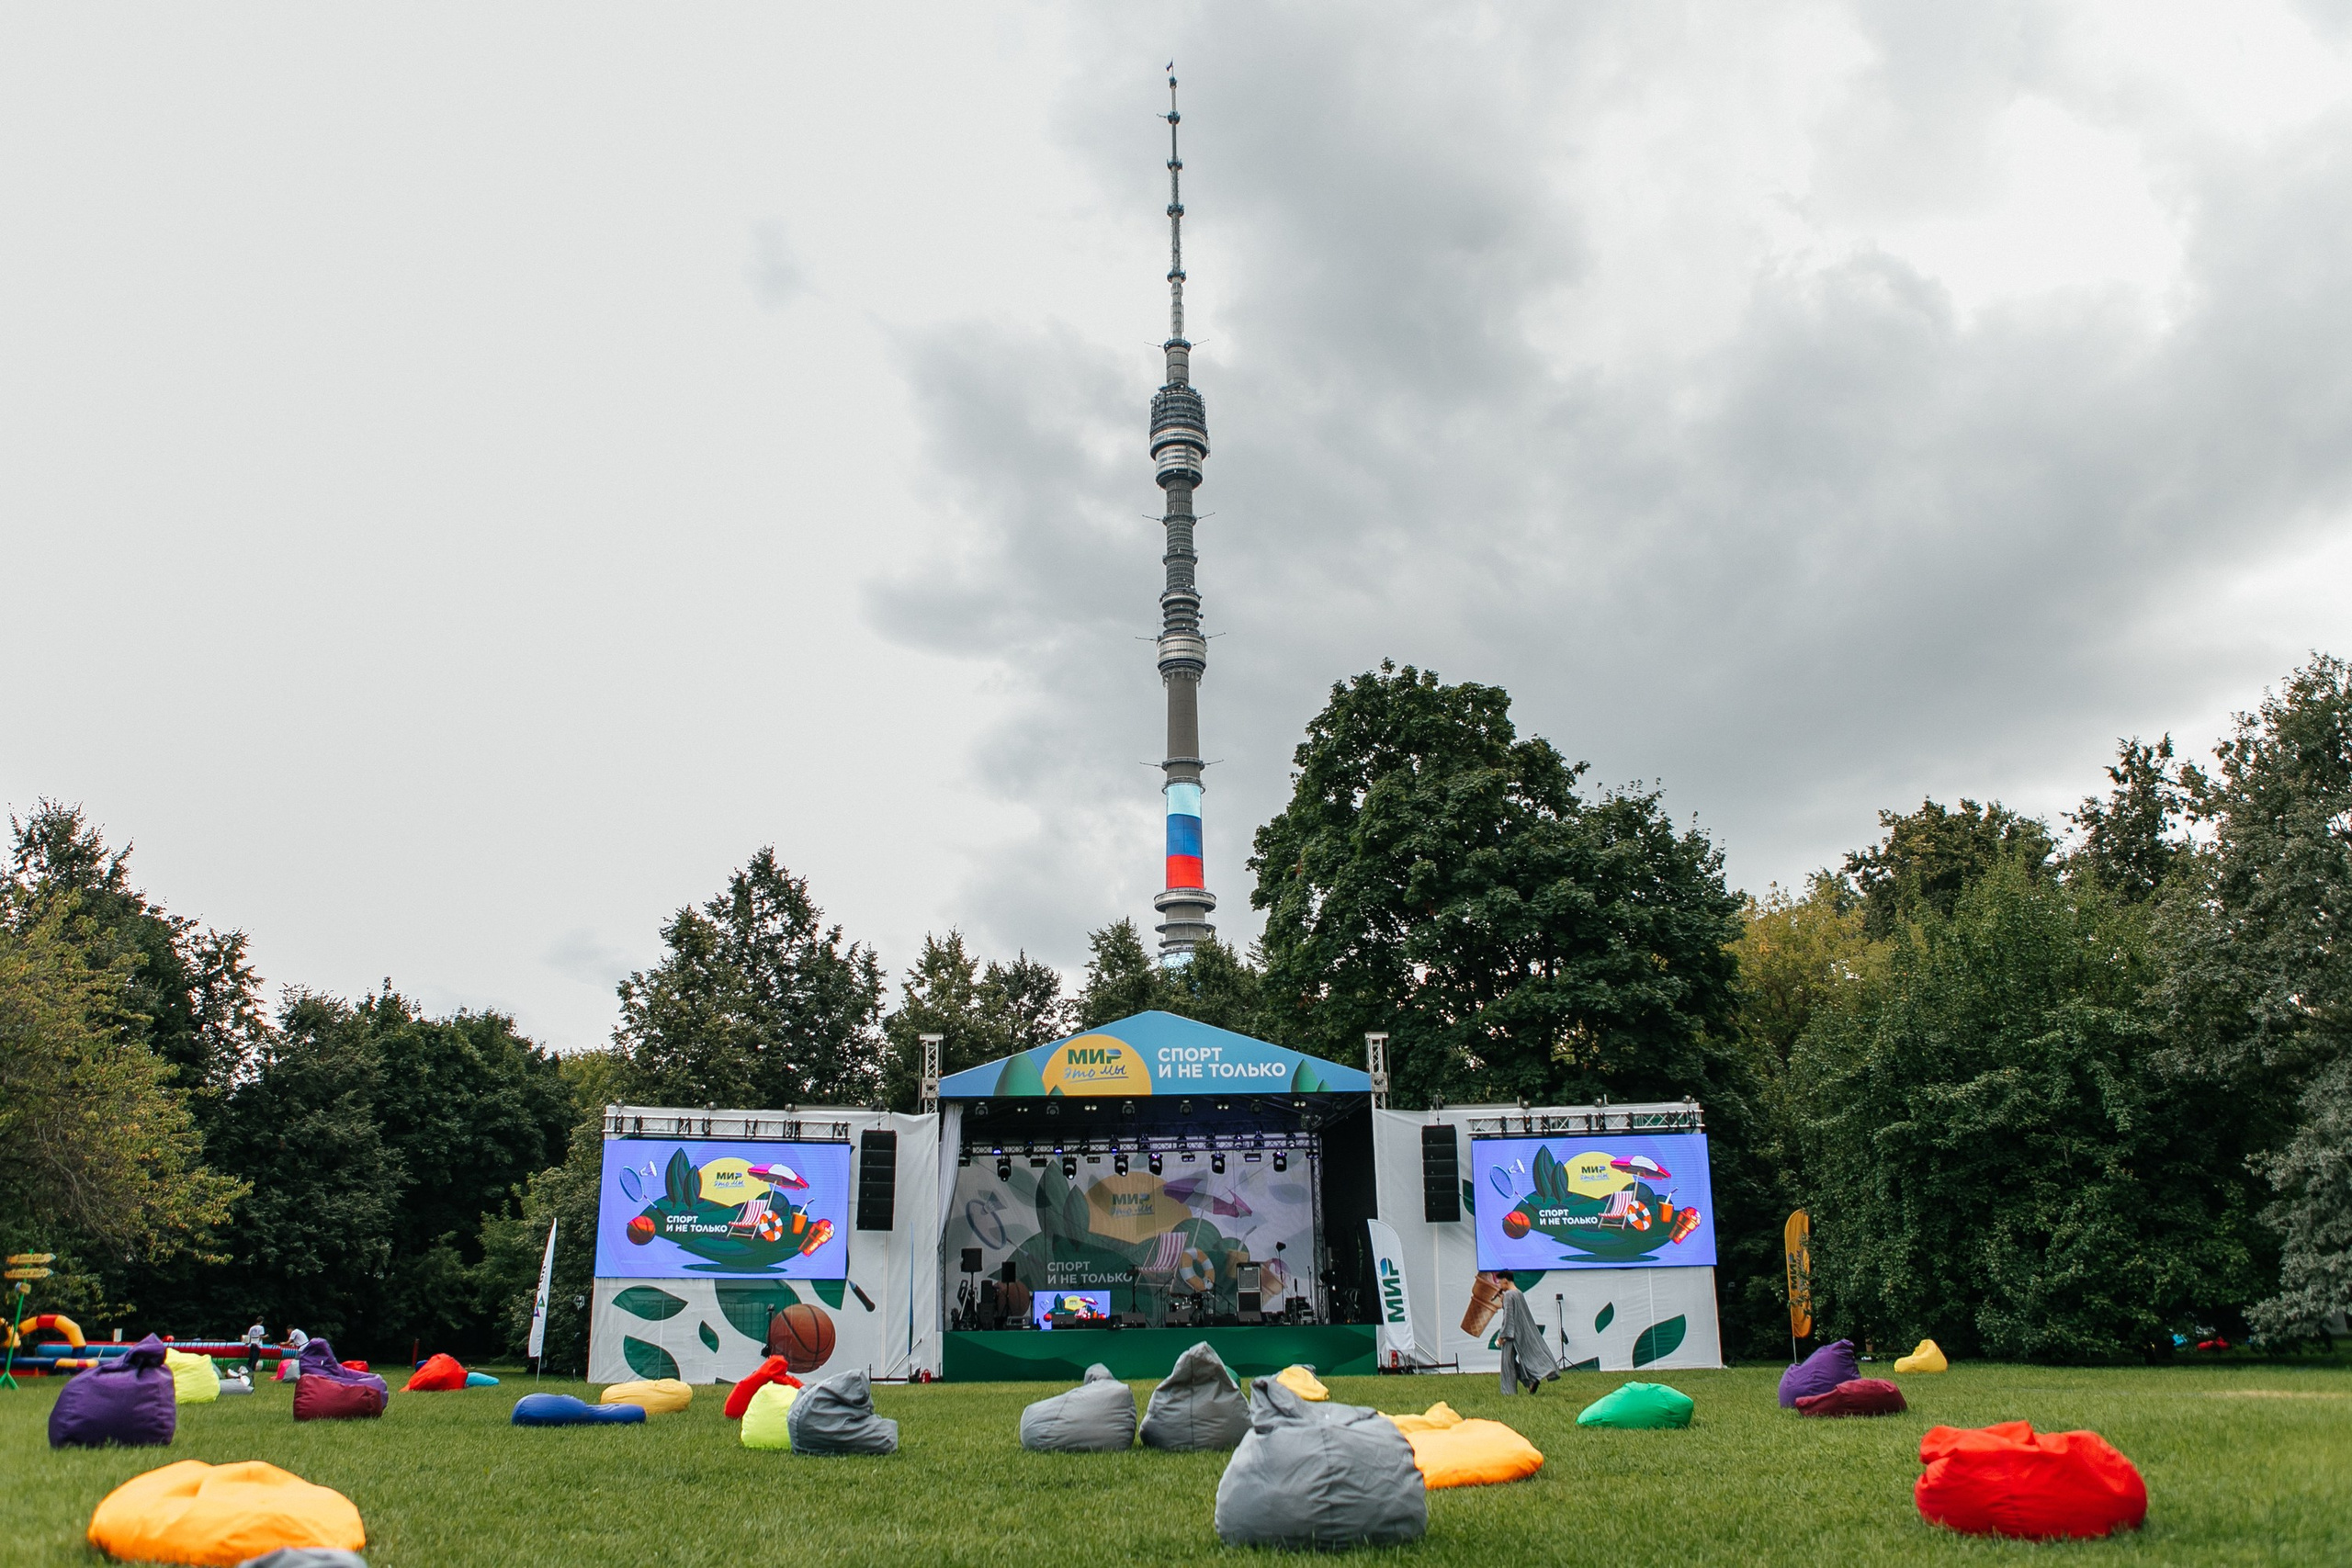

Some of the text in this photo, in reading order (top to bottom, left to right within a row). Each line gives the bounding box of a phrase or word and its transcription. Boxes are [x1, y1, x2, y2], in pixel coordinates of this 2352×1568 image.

[1068, 1049, 1122, 1065] МИР
[1158, 1047, 1223, 1062] СПОРТ
[1064, 1065, 1126, 1079] это мы
[1159, 1062, 1286, 1078] И НЕ ТОЛЬКО
[1113, 1193, 1151, 1204] МИР
[1539, 1209, 1569, 1217] СПОРТ
[666, 1215, 698, 1224] СПОРТ
[1539, 1216, 1599, 1225] И НЕ ТОЛЬКО
[690, 1224, 728, 1233] ТОЛЬКО
[1047, 1261, 1091, 1271] СПОРТ
[1788, 1252, 1797, 1290] МИР
[1047, 1272, 1133, 1284] И НЕ ТОЛЬКО
[1380, 1258, 1406, 1323] МИР
